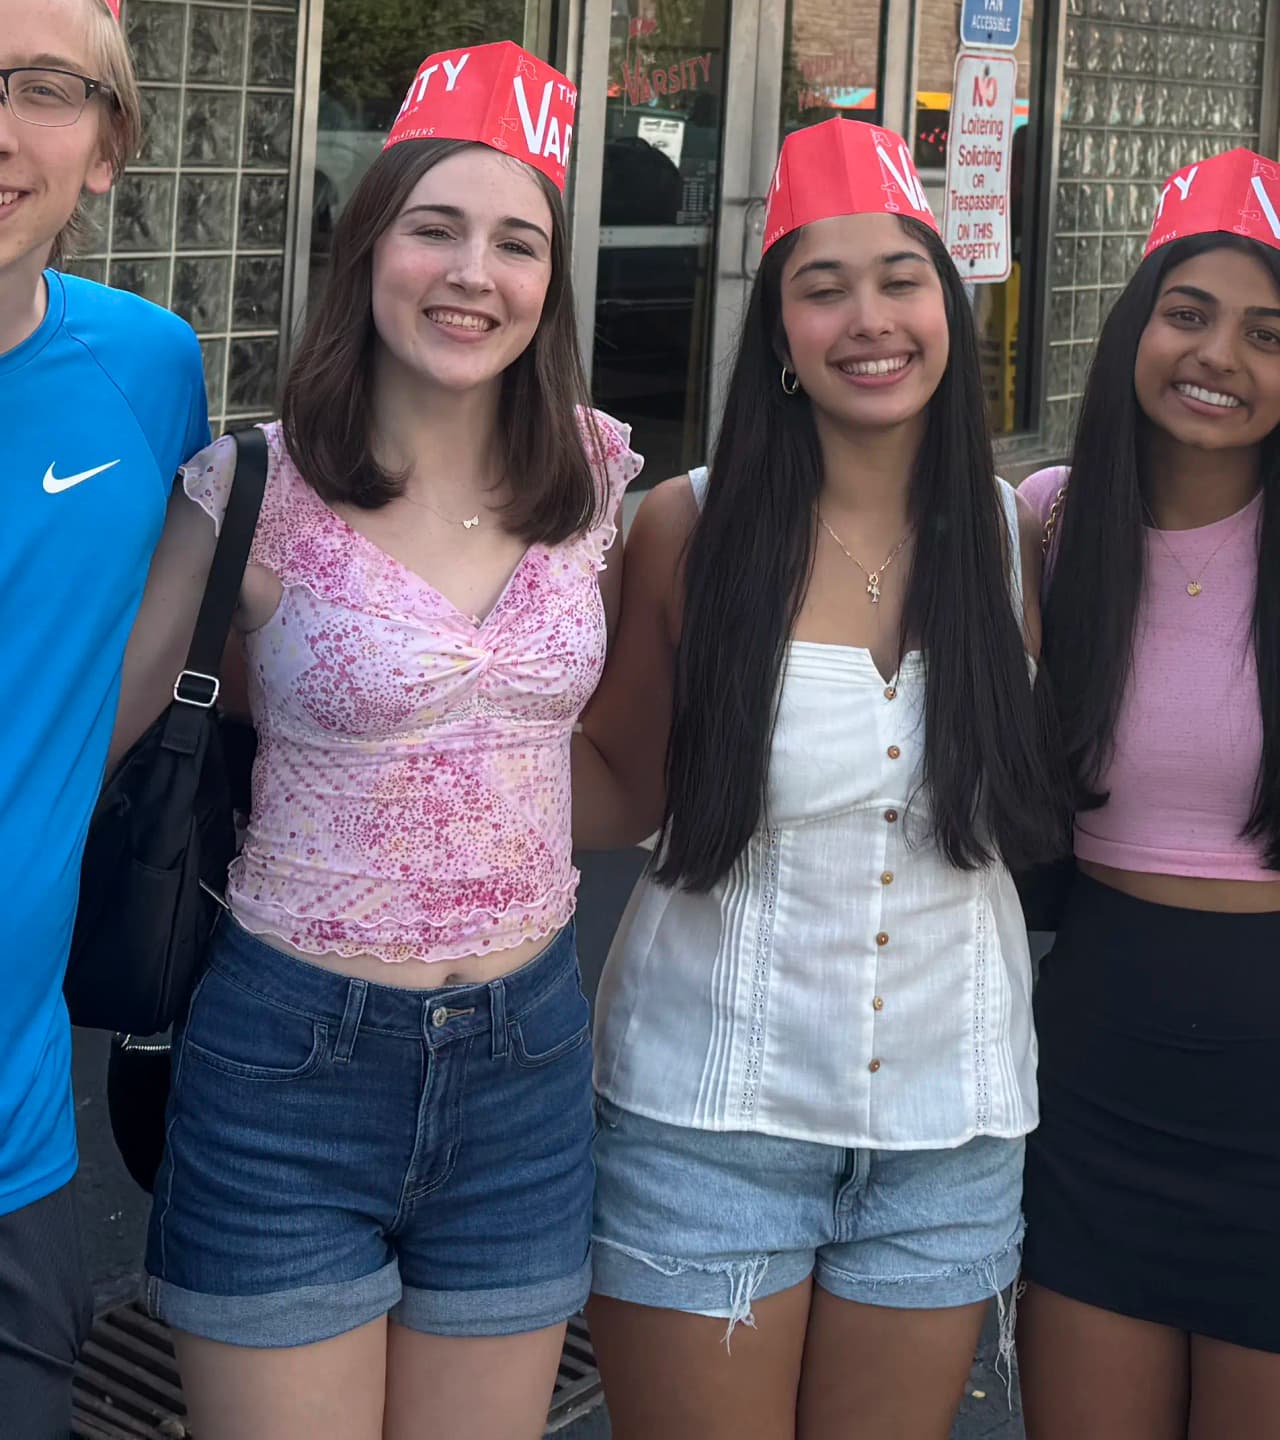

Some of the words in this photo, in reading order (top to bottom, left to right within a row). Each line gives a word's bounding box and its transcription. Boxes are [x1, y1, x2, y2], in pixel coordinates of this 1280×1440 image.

[971, 14, 1013, 33] ACCESSIBLE
[622, 52, 712, 106] VARSITY
[972, 75, 999, 107] NO
[401, 127, 435, 138] ATHENS
[960, 112, 1004, 141] Loitering
[958, 144, 1003, 172] Soliciting
[972, 173, 985, 189] OR
[950, 189, 1006, 216] Trespassing
[957, 223, 970, 241] ON
[973, 222, 994, 240] THIS
[949, 242, 1001, 261] PROPERTY
